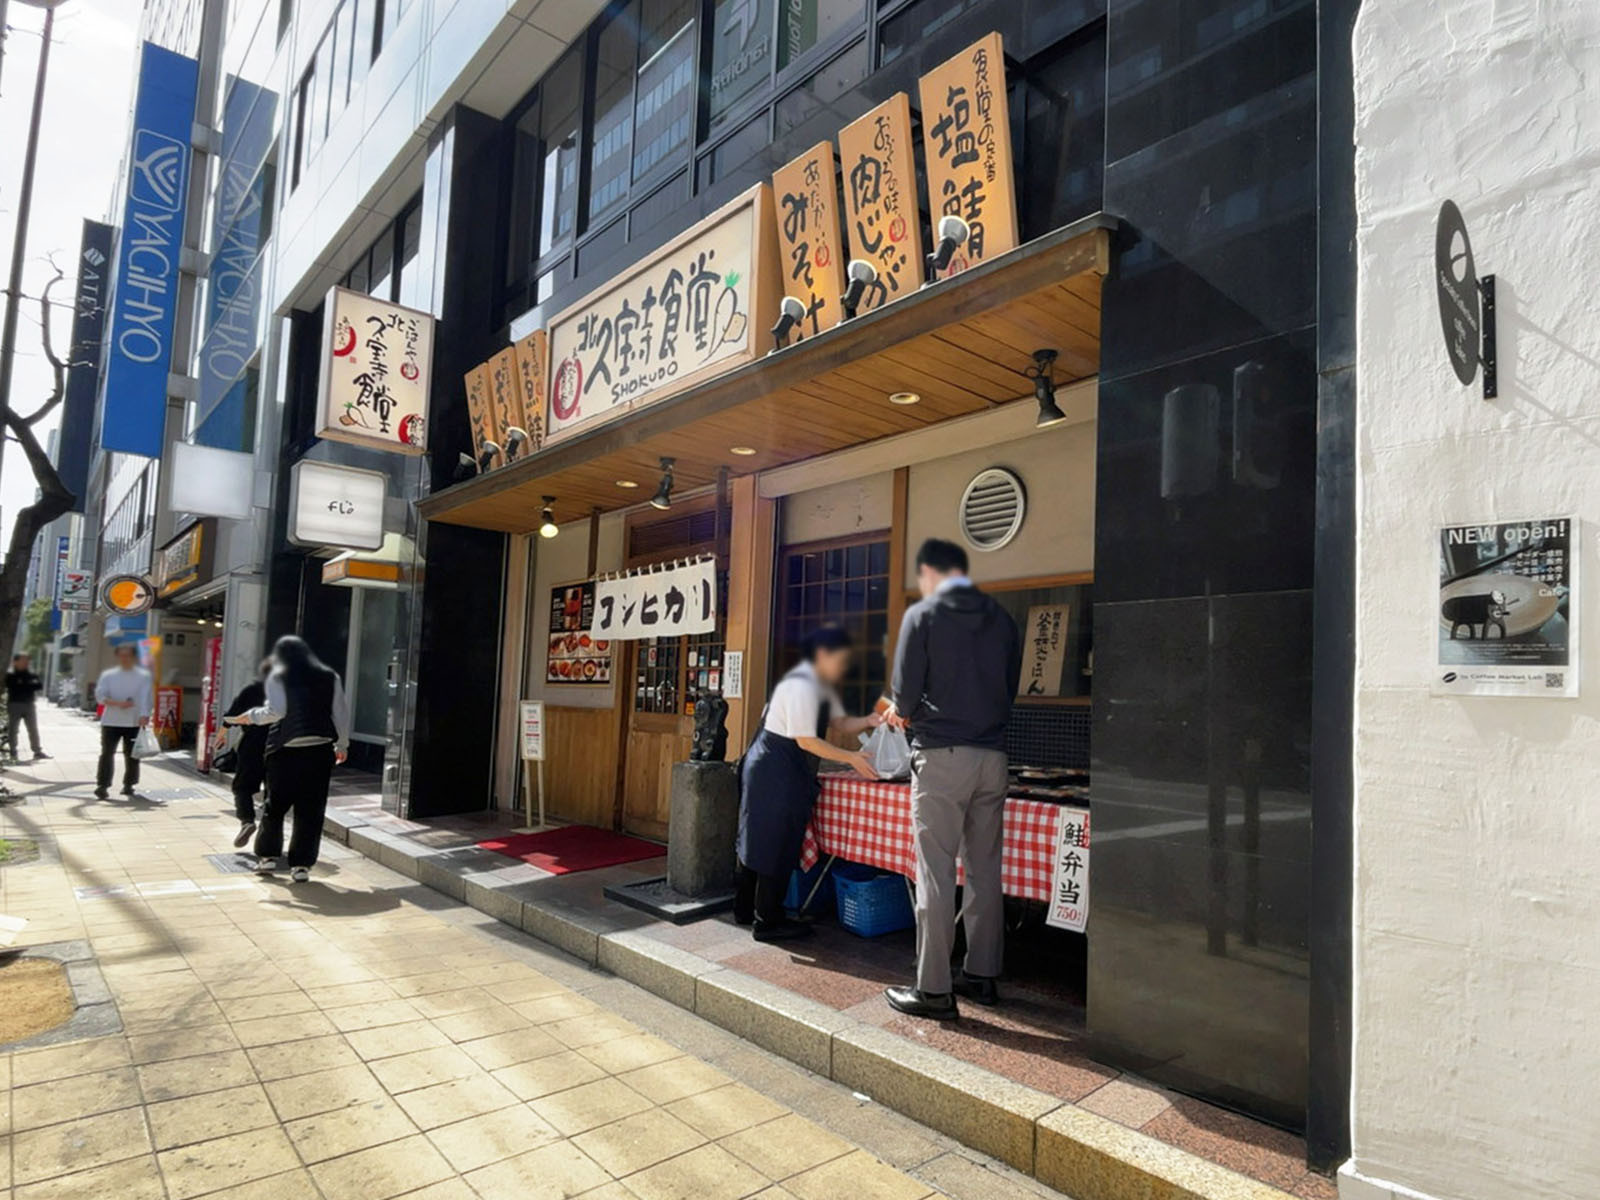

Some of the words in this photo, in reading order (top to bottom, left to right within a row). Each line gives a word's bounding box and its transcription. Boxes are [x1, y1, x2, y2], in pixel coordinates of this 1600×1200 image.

[850, 153, 907, 309] 肉じゃが
[576, 249, 721, 395] 北久宝寺食堂
[611, 361, 678, 404] SHOKUDO
[1448, 526, 1498, 545] NEW
[1503, 520, 1566, 543] open!
[600, 578, 711, 631] コシヒカリ
[1060, 821, 1085, 905] 鮭弁当
